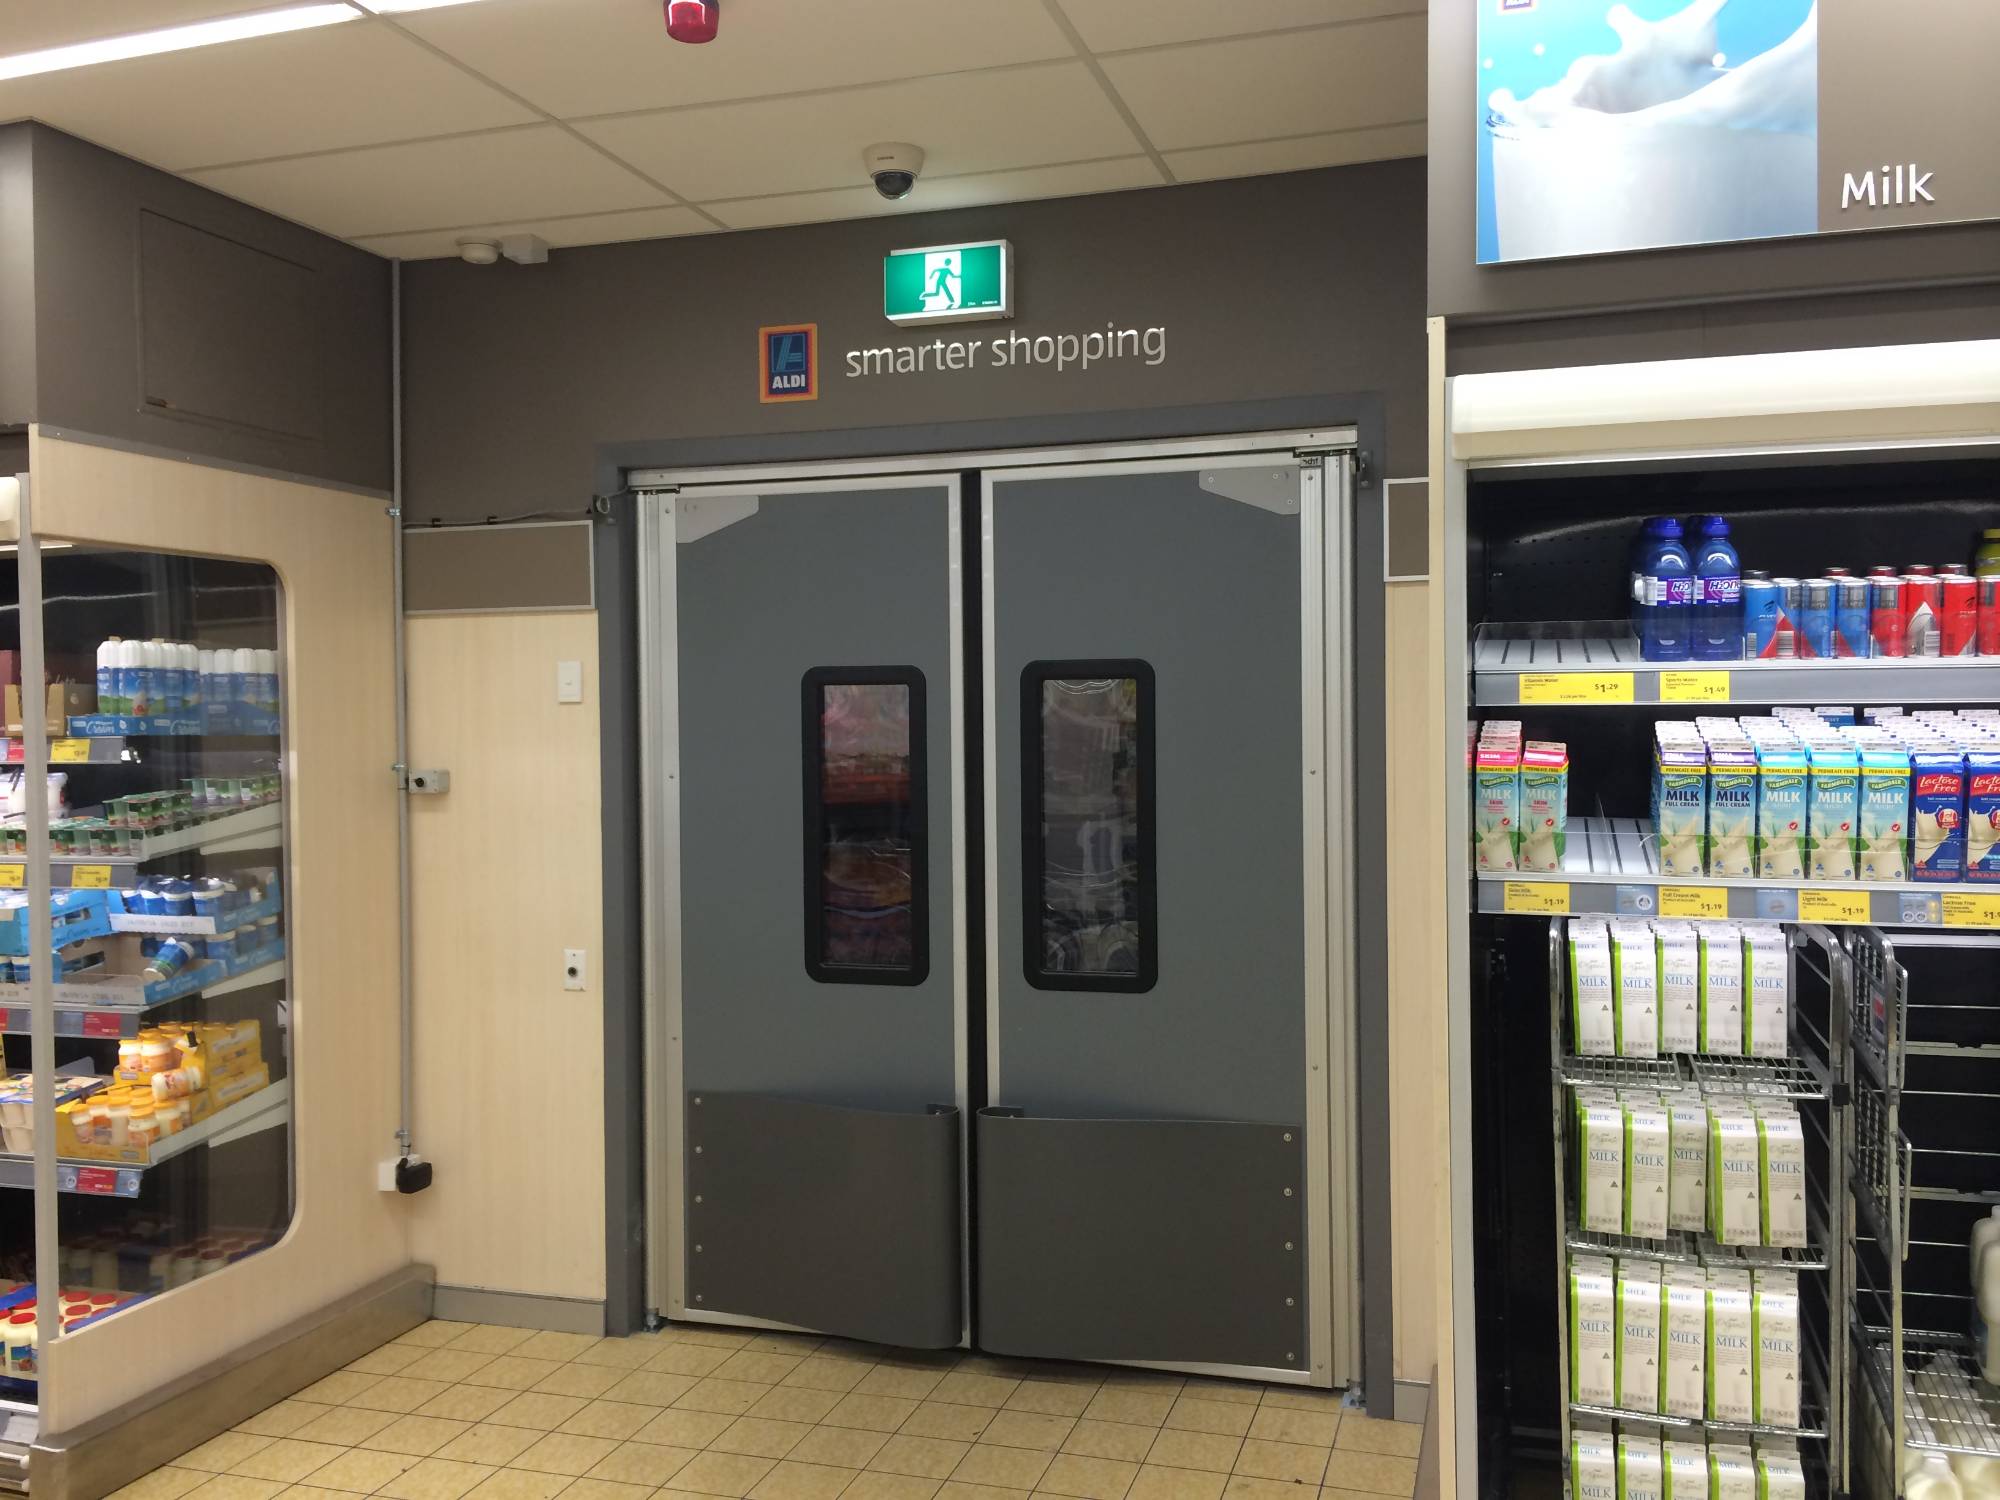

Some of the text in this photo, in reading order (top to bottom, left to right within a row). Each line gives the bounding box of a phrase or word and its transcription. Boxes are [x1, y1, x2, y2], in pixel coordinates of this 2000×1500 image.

[1841, 164, 1935, 209] Milk
[846, 322, 1167, 378] smarter shopping
[772, 374, 806, 389] ALDI
[1595, 683, 1618, 693] $1.29
[1920, 774, 1958, 788] Lactose
[1481, 789, 1512, 800] MILK
[1933, 784, 1958, 793] Free
[1526, 790, 1556, 800] MILK
[1666, 790, 1700, 802] MILK
[1716, 790, 1750, 802] MILK
[1766, 792, 1800, 802] MILK
[1818, 792, 1853, 804] MILK
[1868, 792, 1904, 804] MILK
[1842, 908, 1864, 916] $1.19
[1580, 977, 1608, 987] MILK
[1624, 978, 1652, 989] MILK
[1664, 976, 1694, 986] MILK
[1709, 976, 1738, 987] MILK
[1754, 978, 1784, 989] MILK
[1589, 1151, 1618, 1162] MILK
[1634, 1155, 1664, 1167] MILK
[1674, 1150, 1704, 1161] MILK
[1724, 1161, 1754, 1173] MILK
[1770, 1162, 1801, 1174] MILK
[1580, 1321, 1610, 1333] MILK
[1624, 1326, 1655, 1338] MILK
[1670, 1332, 1700, 1345] MILK
[1716, 1336, 1748, 1348] MILK
[1762, 1340, 1793, 1352] MILK
[1580, 1486, 1612, 1499] MILK
[1628, 1490, 1657, 1500] MILK
